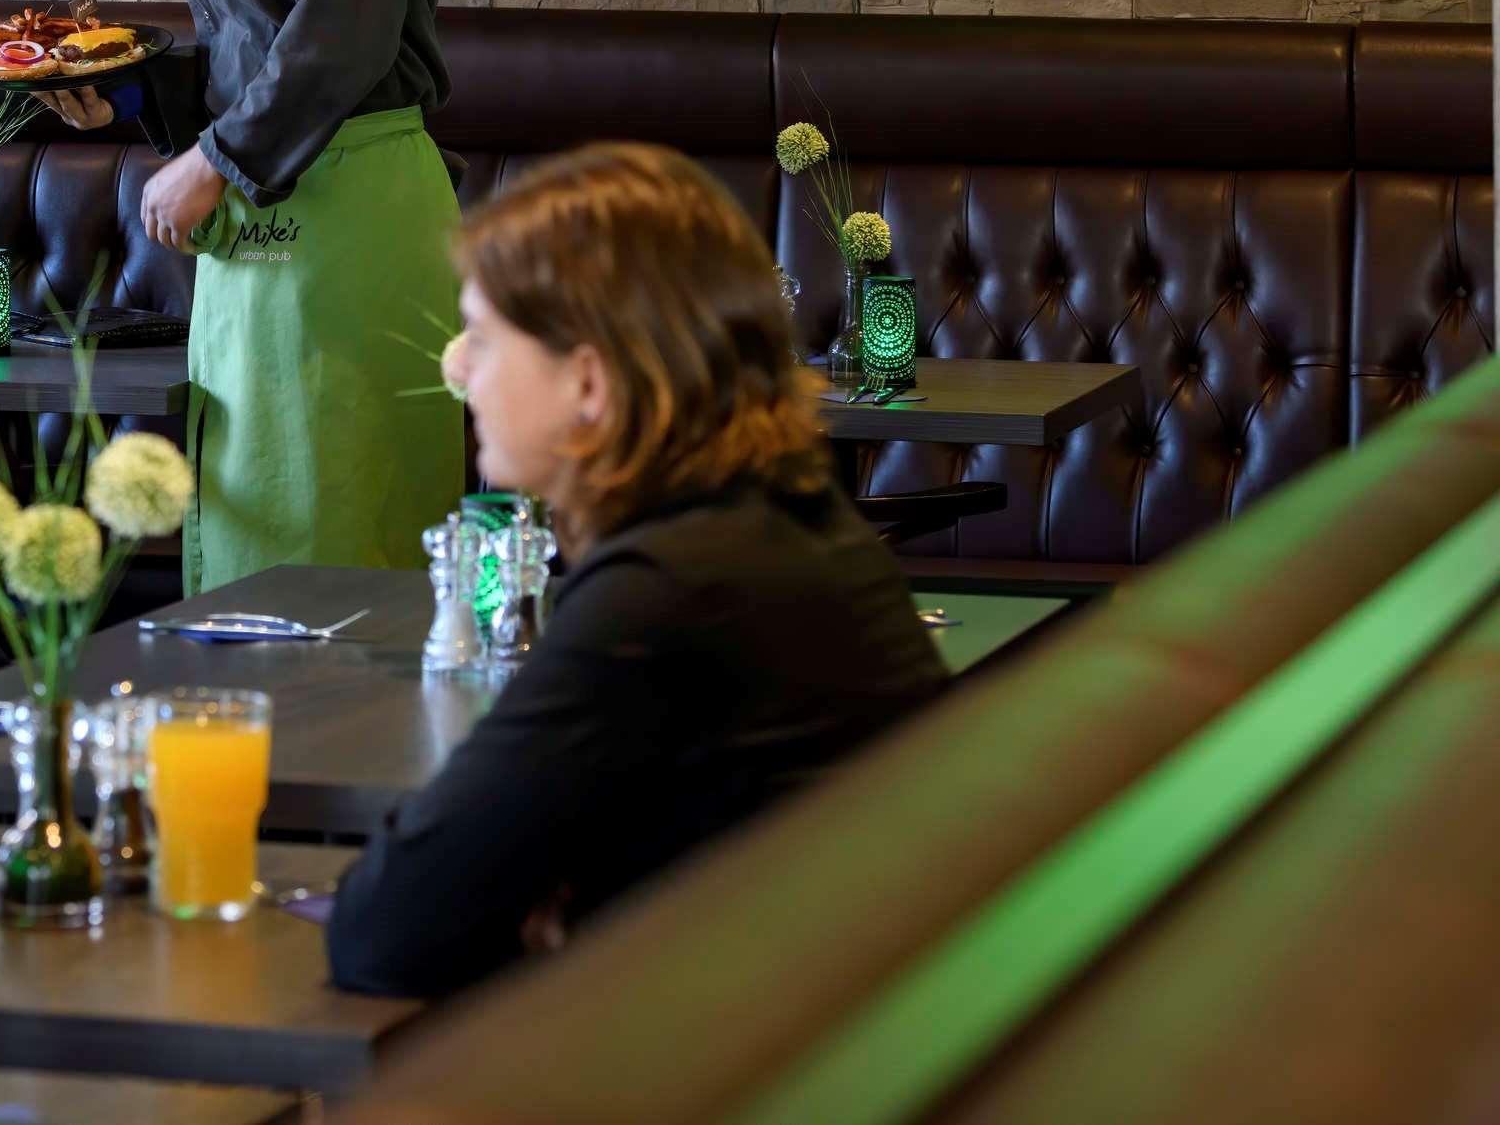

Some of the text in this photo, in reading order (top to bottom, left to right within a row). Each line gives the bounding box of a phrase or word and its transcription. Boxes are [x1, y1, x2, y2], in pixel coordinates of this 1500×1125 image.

[228, 208, 301, 259] Mike's
[240, 250, 292, 263] urban pub
